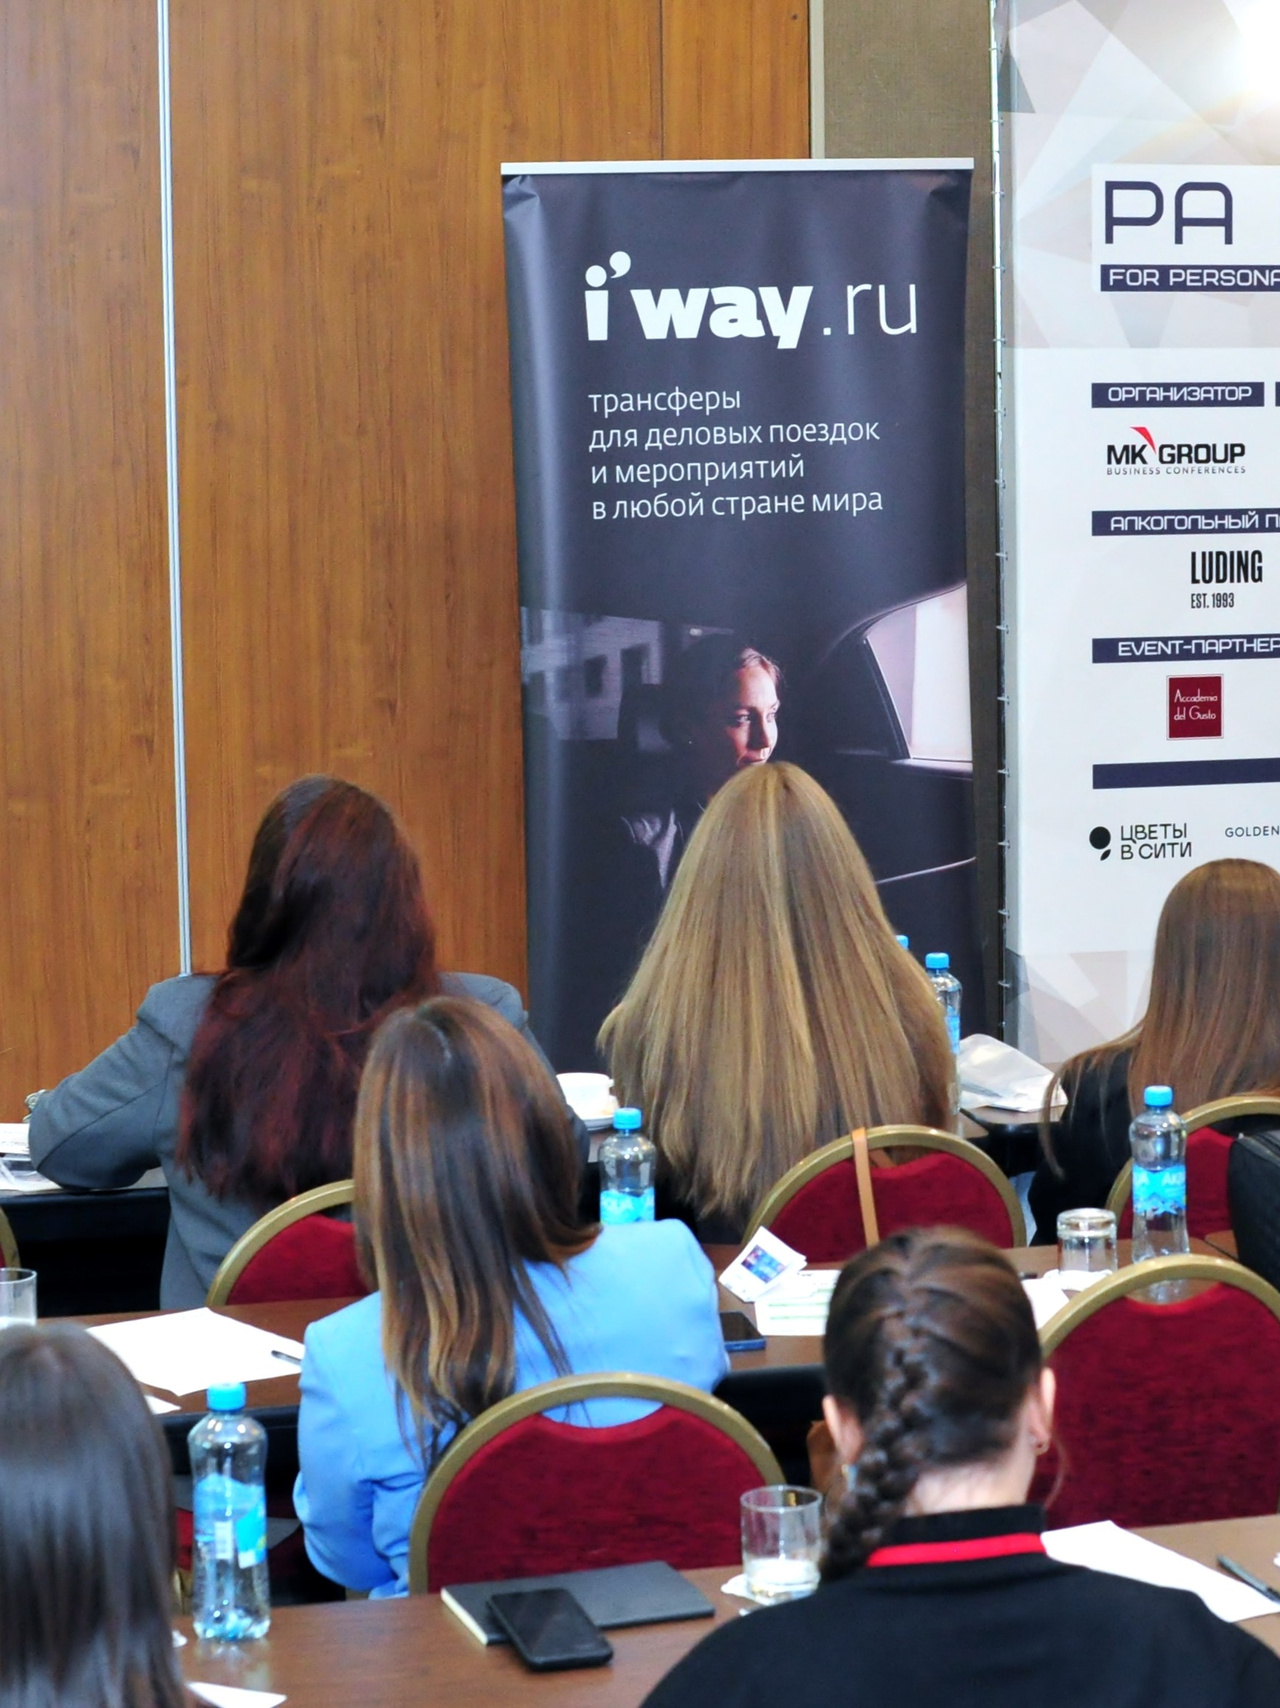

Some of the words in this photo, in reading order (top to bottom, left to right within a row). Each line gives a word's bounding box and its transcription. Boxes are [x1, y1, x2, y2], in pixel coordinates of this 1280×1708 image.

[1105, 180, 1233, 244] PA
[1109, 269, 1160, 286] FOR
[588, 386, 741, 418] трансферы
[1108, 386, 1252, 402] ОРГАНИЗАТОР
[589, 425, 638, 453] для
[645, 424, 762, 451] деловых
[769, 420, 880, 447] поездок
[1107, 444, 1148, 465] MK
[1158, 443, 1246, 465] GROUP
[592, 465, 608, 485] и
[615, 453, 805, 489] мероприятий
[1107, 467, 1161, 476] BUSINESS
[1166, 465, 1247, 475] CONFERENCES
[592, 502, 607, 520] в
[613, 489, 705, 519] любой
[711, 493, 805, 521] стране
[812, 490, 883, 516] мира
[1111, 511, 1259, 531] АЛКОГОЛЬНЫЙ
[1190, 550, 1263, 585] LUDING
[1190, 593, 1210, 609] EST.
[1212, 592, 1235, 609] 1993
[1173, 707, 1186, 721] del
[1188, 705, 1217, 721] Gusto
[1120, 822, 1188, 845] ЦВЕТЫ
[1224, 825, 1280, 838] GOLDEN
[1120, 844, 1134, 860] В
[1138, 841, 1192, 860] СИТИ
